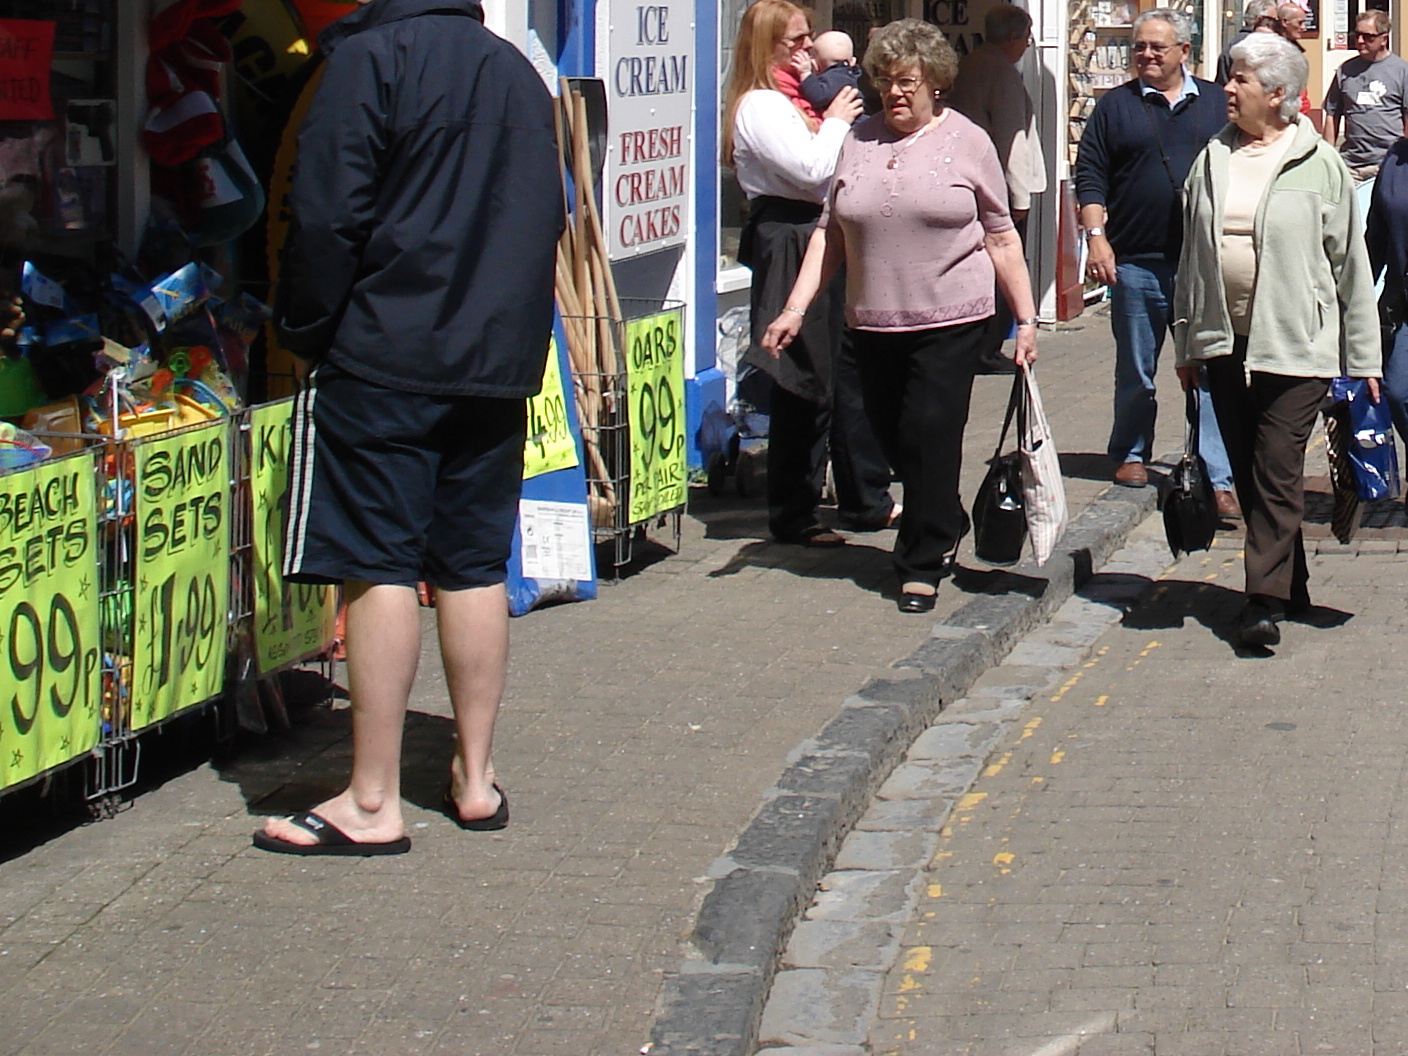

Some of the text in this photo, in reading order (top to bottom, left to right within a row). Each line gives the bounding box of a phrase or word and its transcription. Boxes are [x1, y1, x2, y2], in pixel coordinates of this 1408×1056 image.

[635, 6, 669, 46] ICE
[615, 54, 687, 98] CREAM
[619, 126, 683, 166] FRESH
[615, 165, 685, 207] CREAM
[619, 205, 680, 248] CAKES
[633, 320, 676, 369] OARS
[142, 434, 222, 502] SAND
[258, 424, 293, 474] KI
[0, 471, 79, 535] BEACH
[142, 491, 222, 563] SETS
[0, 517, 89, 594] SETS
